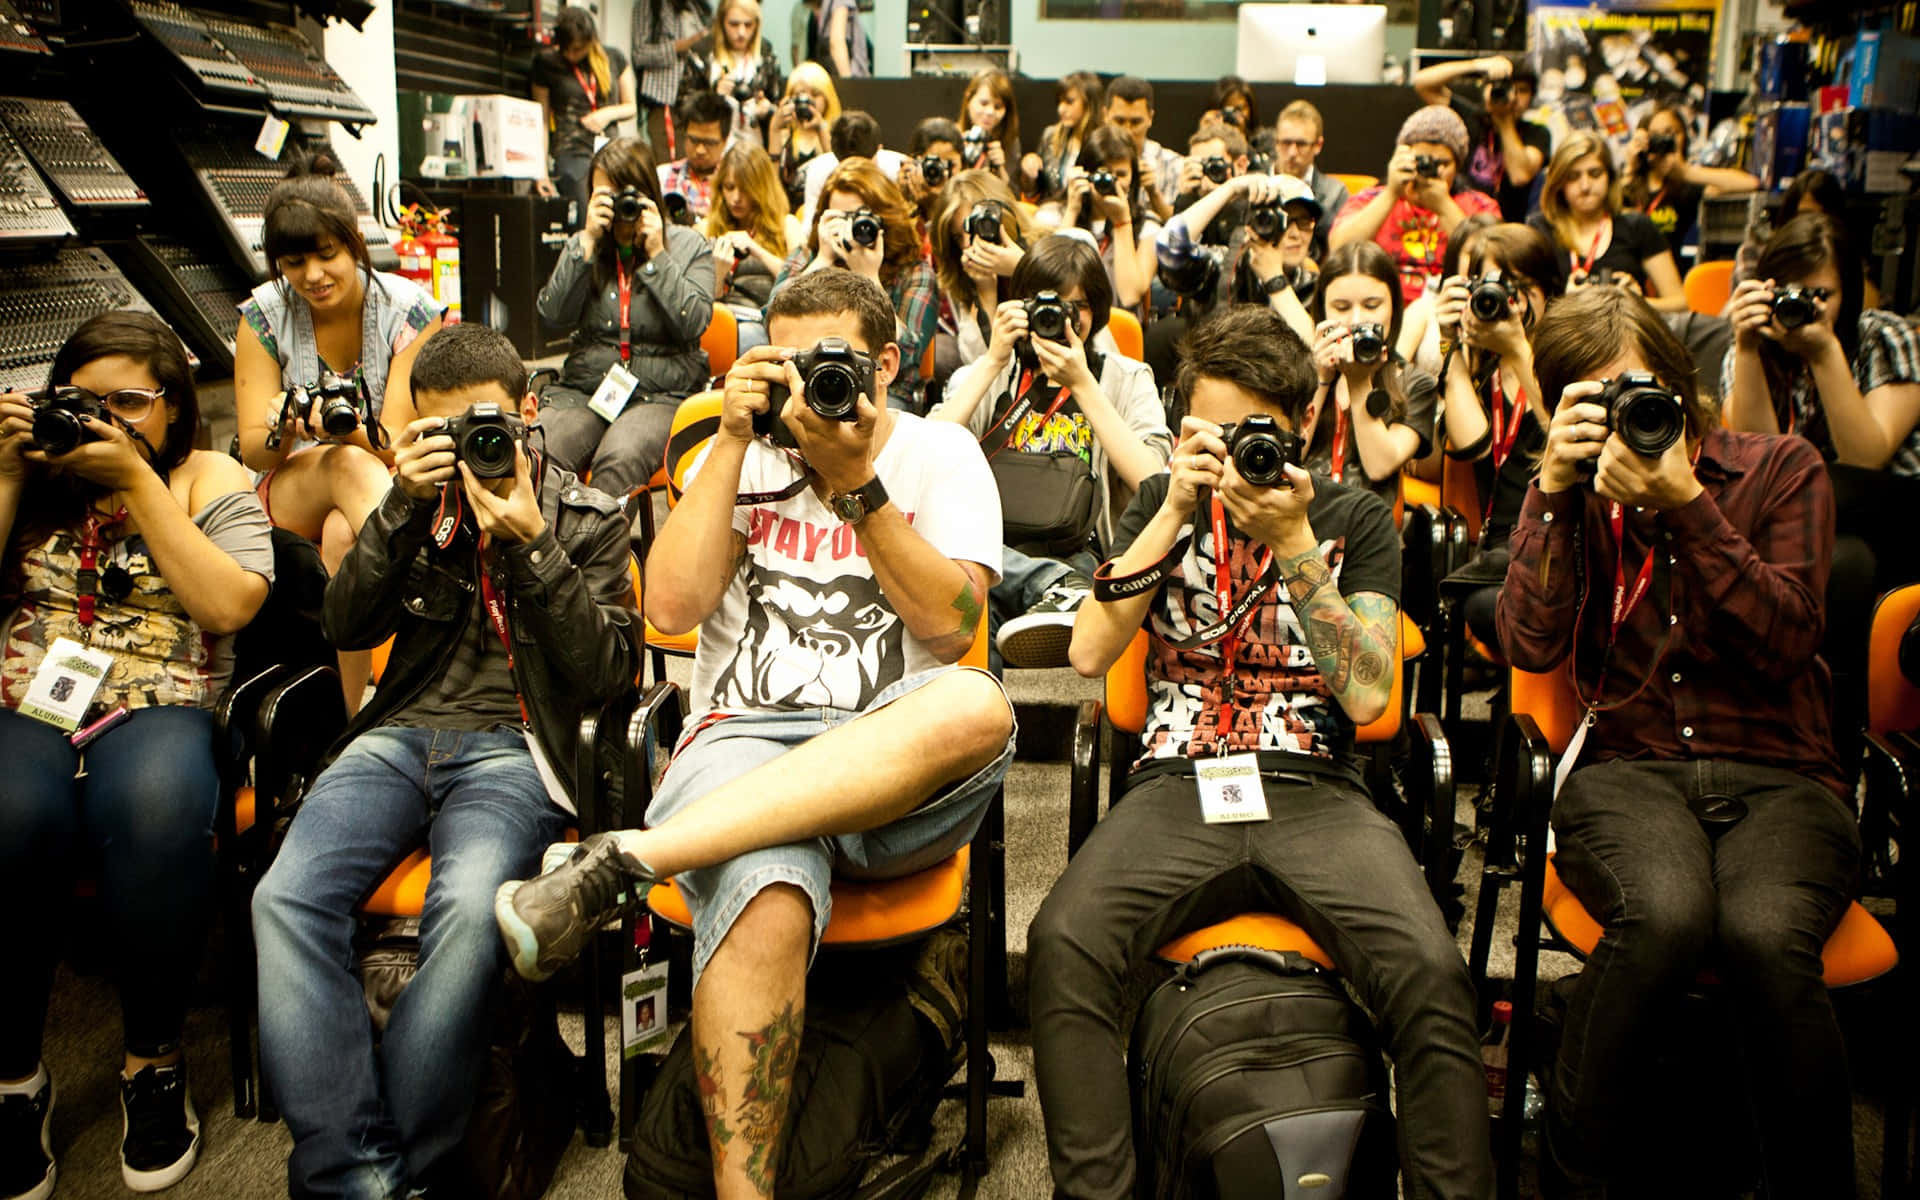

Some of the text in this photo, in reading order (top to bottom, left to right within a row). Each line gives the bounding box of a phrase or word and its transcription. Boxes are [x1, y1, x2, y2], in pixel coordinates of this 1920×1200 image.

[1004, 398, 1031, 429] Canon
[435, 516, 455, 541] EOS
[747, 507, 828, 563] STAY
[1109, 569, 1162, 594] Canon
[1200, 623, 1228, 641] EOS
[1229, 584, 1267, 625] DIGITAL
[31, 708, 65, 725] ALUNO
